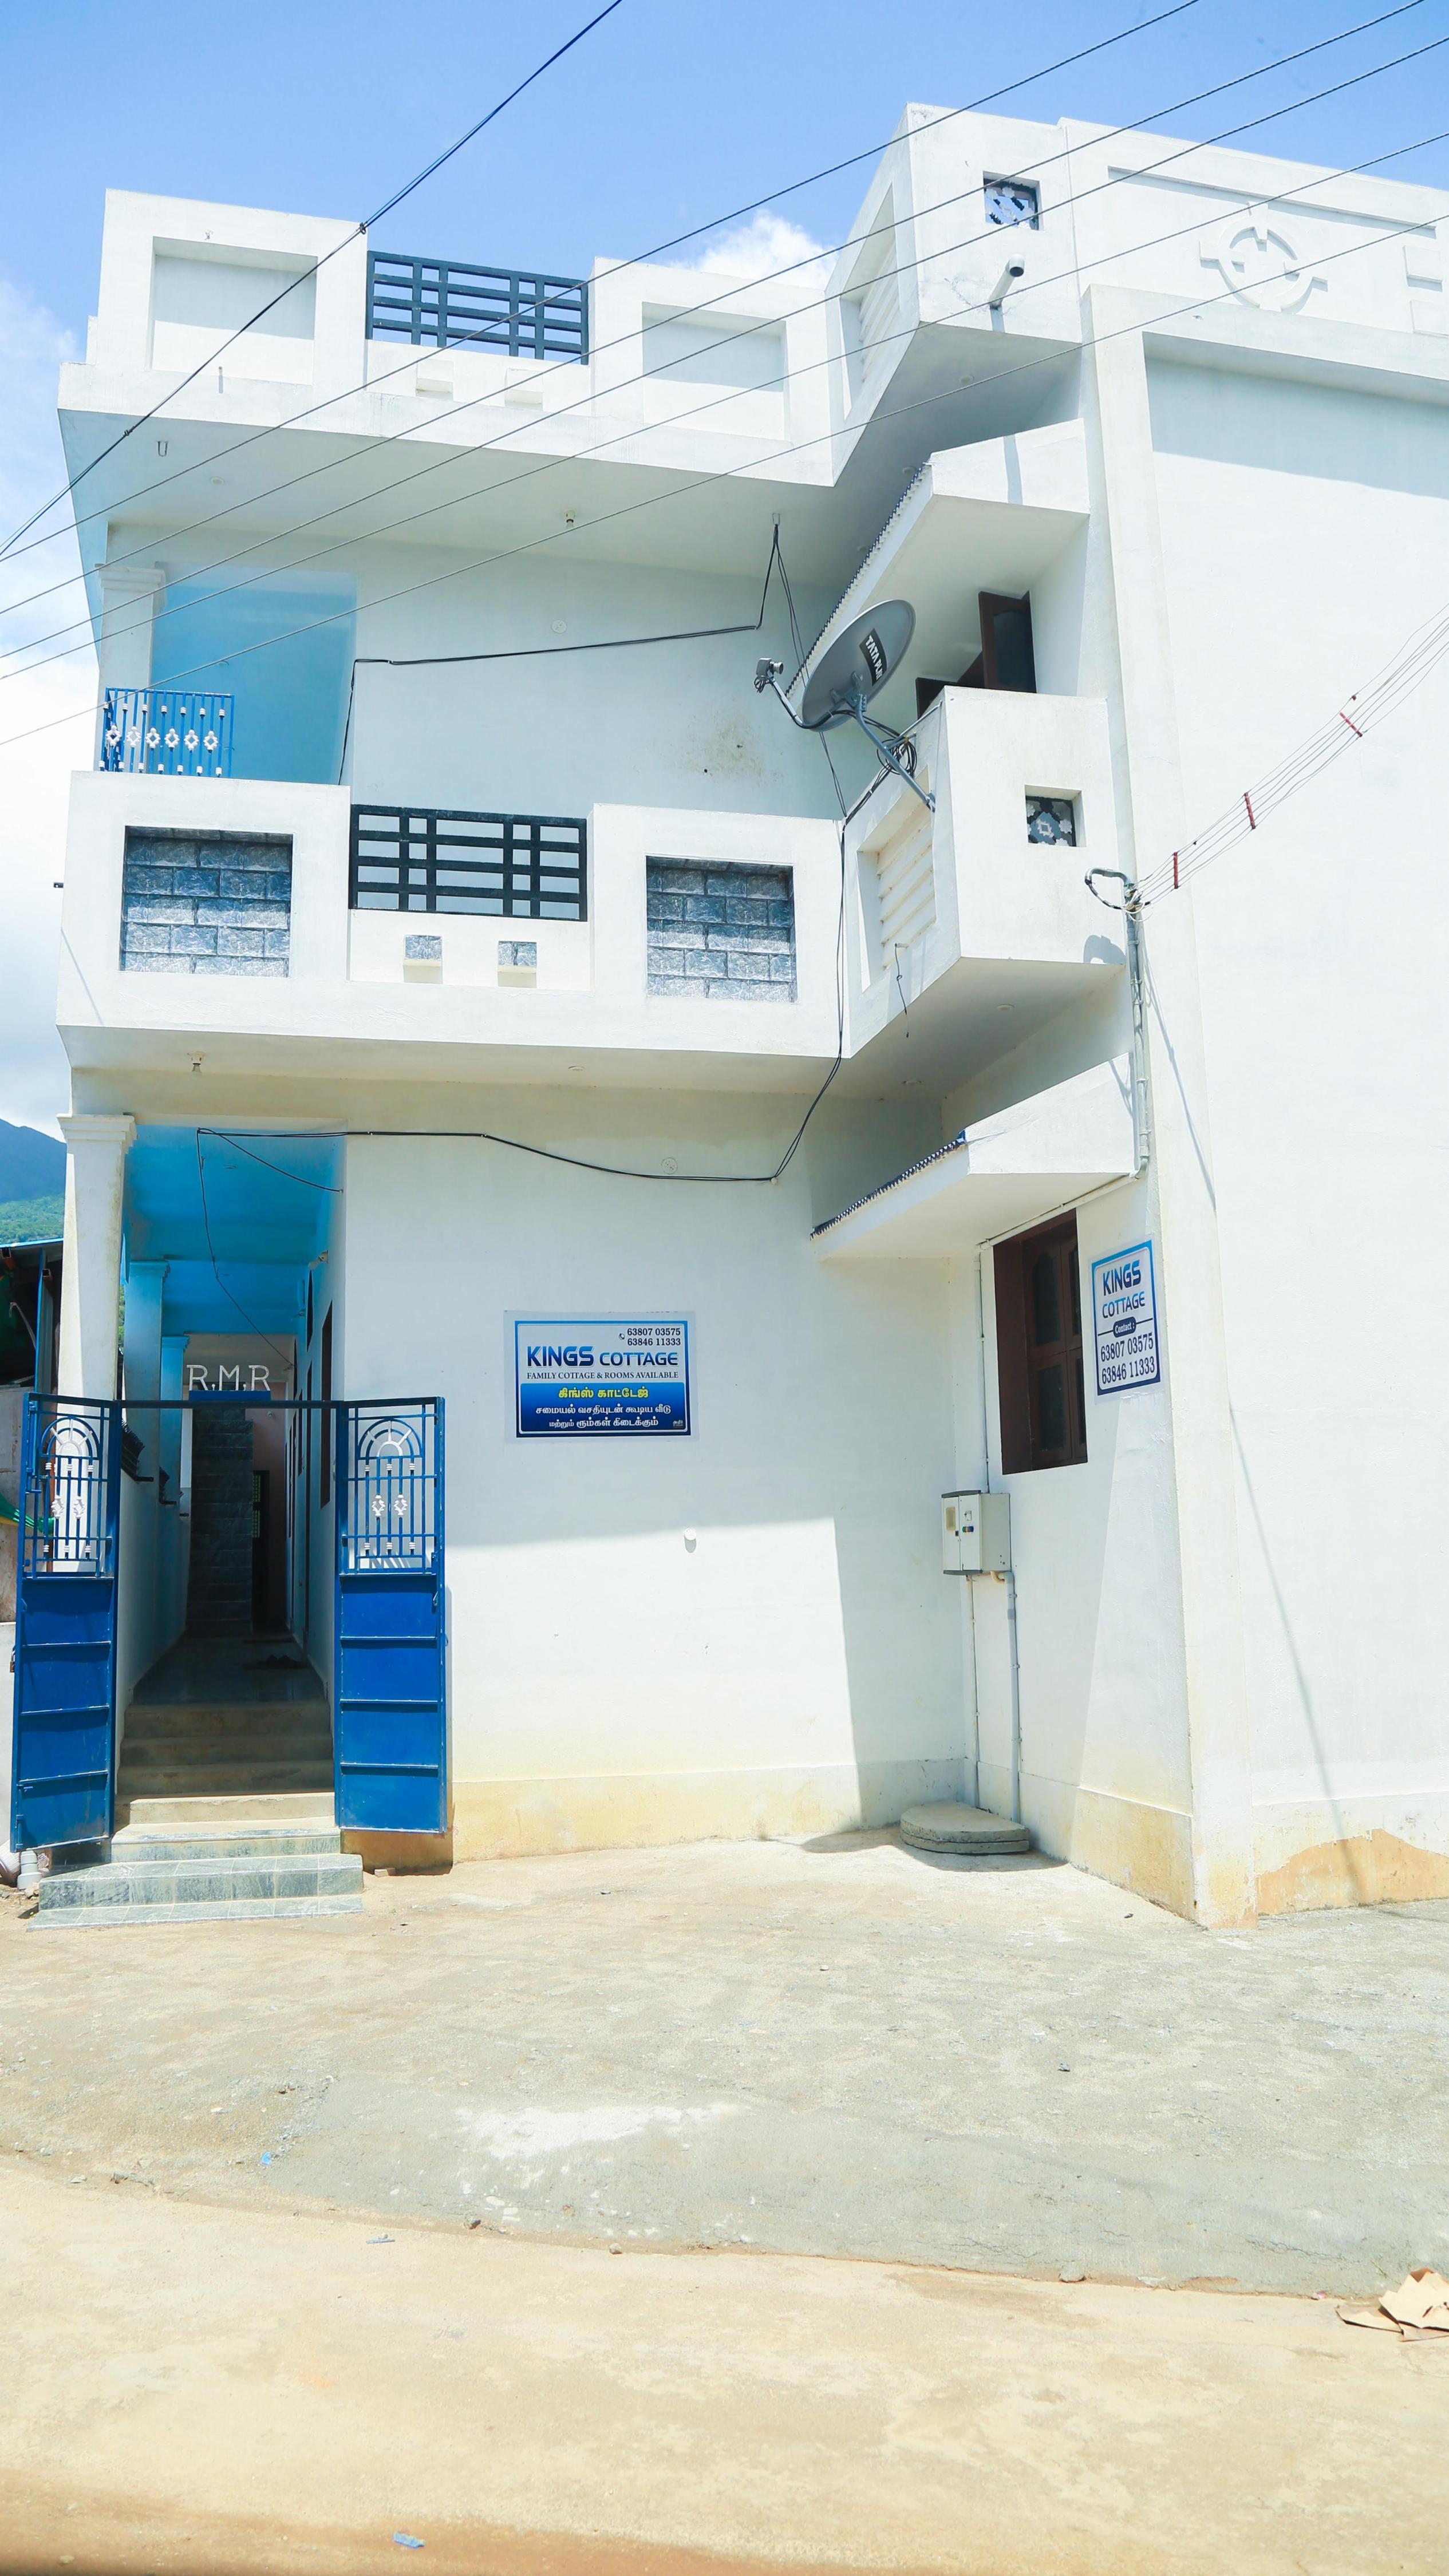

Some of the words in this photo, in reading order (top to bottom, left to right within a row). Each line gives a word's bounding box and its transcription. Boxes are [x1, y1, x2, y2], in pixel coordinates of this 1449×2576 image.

[866, 635, 879, 663] TATA
[1103, 1259, 1141, 1296] KINGS
[1102, 1291, 1146, 1318] COTTAGE
[627, 1338, 653, 1346] 63846
[656, 1338, 681, 1346] 11333
[1100, 1340, 1124, 1362] 63807
[1127, 1332, 1154, 1355] 03575
[527, 1346, 594, 1366] KINGS
[599, 1352, 678, 1366] COTTAGE
[1102, 1363, 1127, 1384] 63846
[1130, 1356, 1155, 1378] 11333
[558, 1386, 594, 1398] கிங்ஸ்
[597, 1386, 649, 1398] காட்டேஜ்
[535, 1404, 576, 1414] சமையல்
[578, 1403, 623, 1415] வசதியுடன்
[625, 1406, 653, 1415] கூடிய
[655, 1404, 671, 1414] வீடு
[549, 1419, 574, 1428] மற்றும்
[576, 1417, 611, 1428] ரூம்கள்
[613, 1416, 658, 1427] கிடைக்கும்
